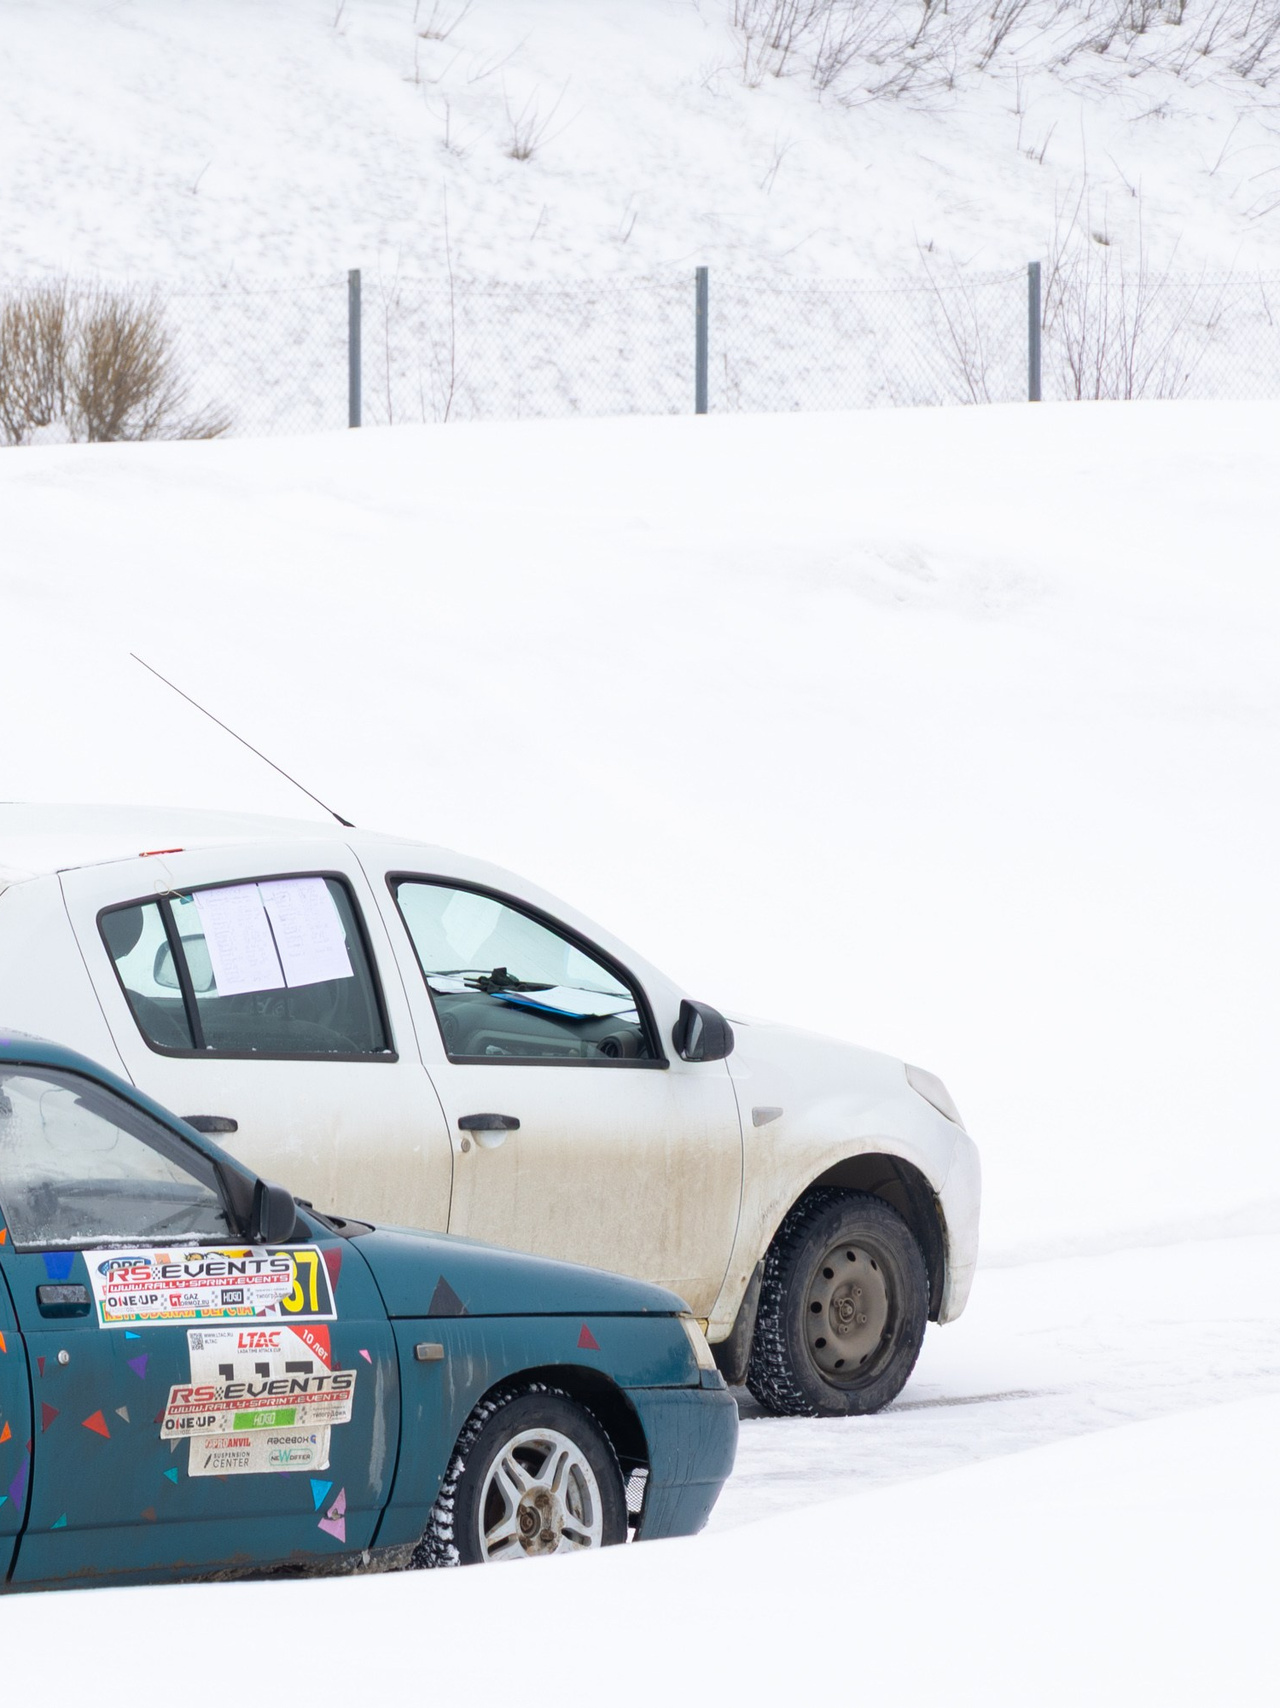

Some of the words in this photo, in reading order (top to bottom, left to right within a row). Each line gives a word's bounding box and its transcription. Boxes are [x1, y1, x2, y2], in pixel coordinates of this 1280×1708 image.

[161, 1258, 290, 1279] EVENTS
[237, 1331, 281, 1349] LTAC
[302, 1328, 314, 1345] 10
[312, 1344, 329, 1360] лет
[224, 1373, 353, 1400] EVENTS
[212, 1458, 250, 1469] CENTER
